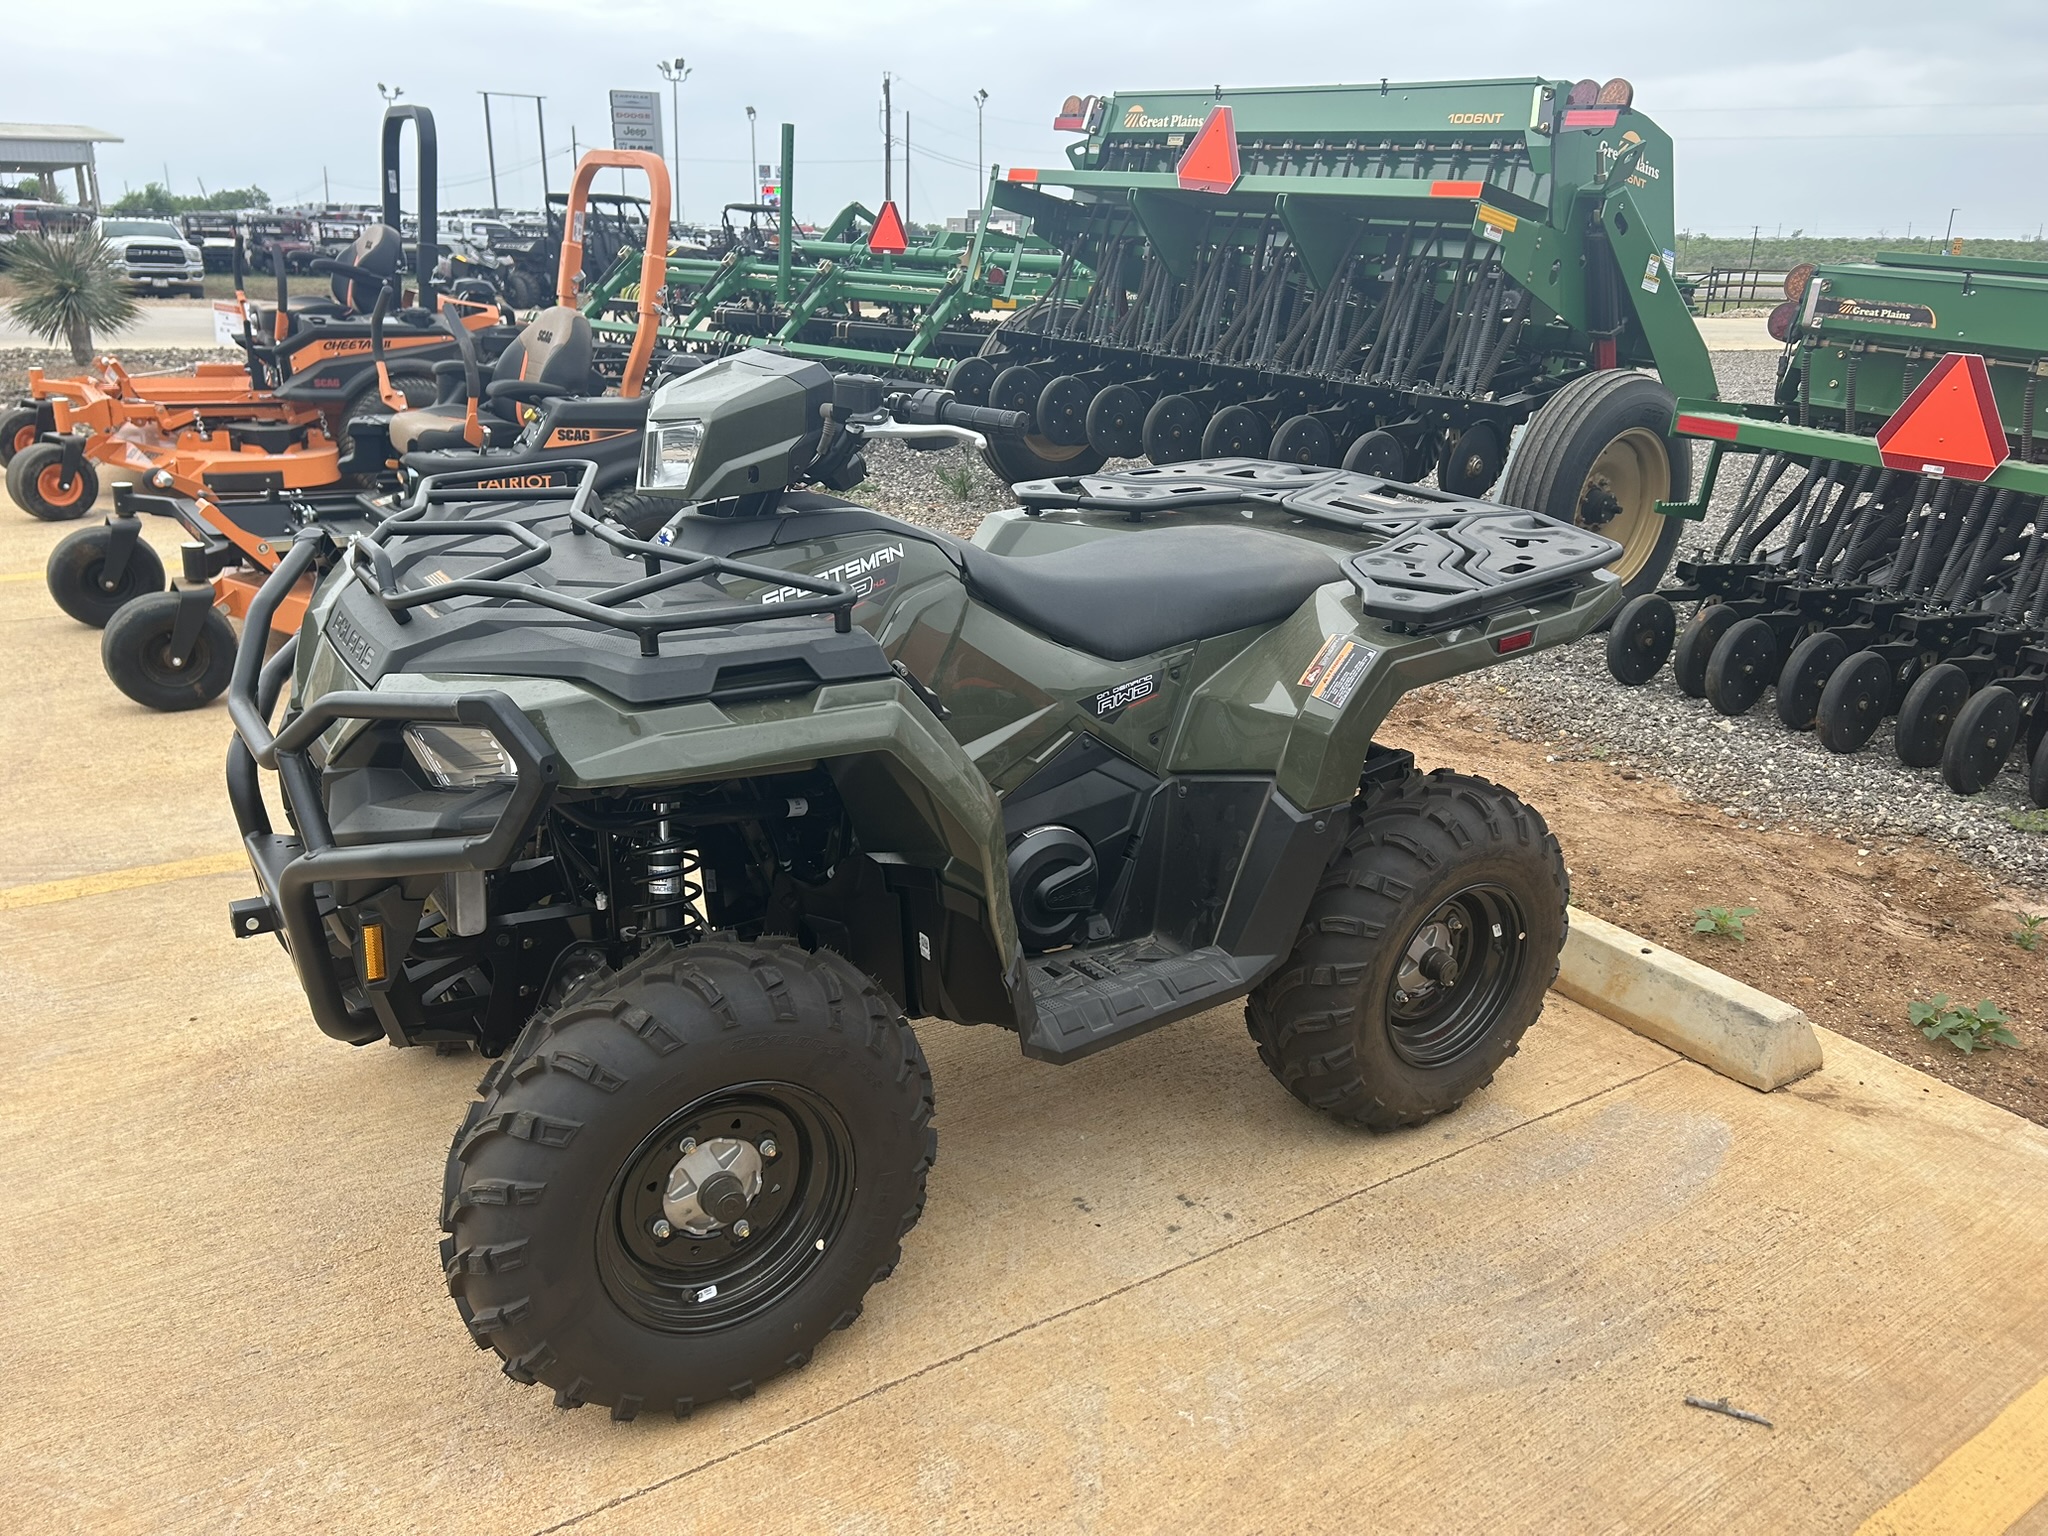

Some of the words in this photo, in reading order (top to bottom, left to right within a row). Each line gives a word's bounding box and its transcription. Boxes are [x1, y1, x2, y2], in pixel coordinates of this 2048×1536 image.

[1139, 114, 1169, 128] Great
[1169, 114, 1204, 128] Plains
[1447, 113, 1505, 124] 1006NT
[623, 126, 647, 137] Jeep
[1635, 158, 1660, 180] lains
[1852, 306, 1879, 317] Great
[1880, 308, 1911, 320] Plains
[537, 330, 553, 344] SCAG
[323, 340, 372, 351] CHEETA
[557, 429, 590, 442] SCAG
[478, 475, 552, 490] PATRIOT
[332, 610, 376, 671] POLARIS
[1326, 654, 1344, 677] WARNING
[1112, 674, 1153, 694] DEMAND
[1097, 681, 1153, 714] AWD
